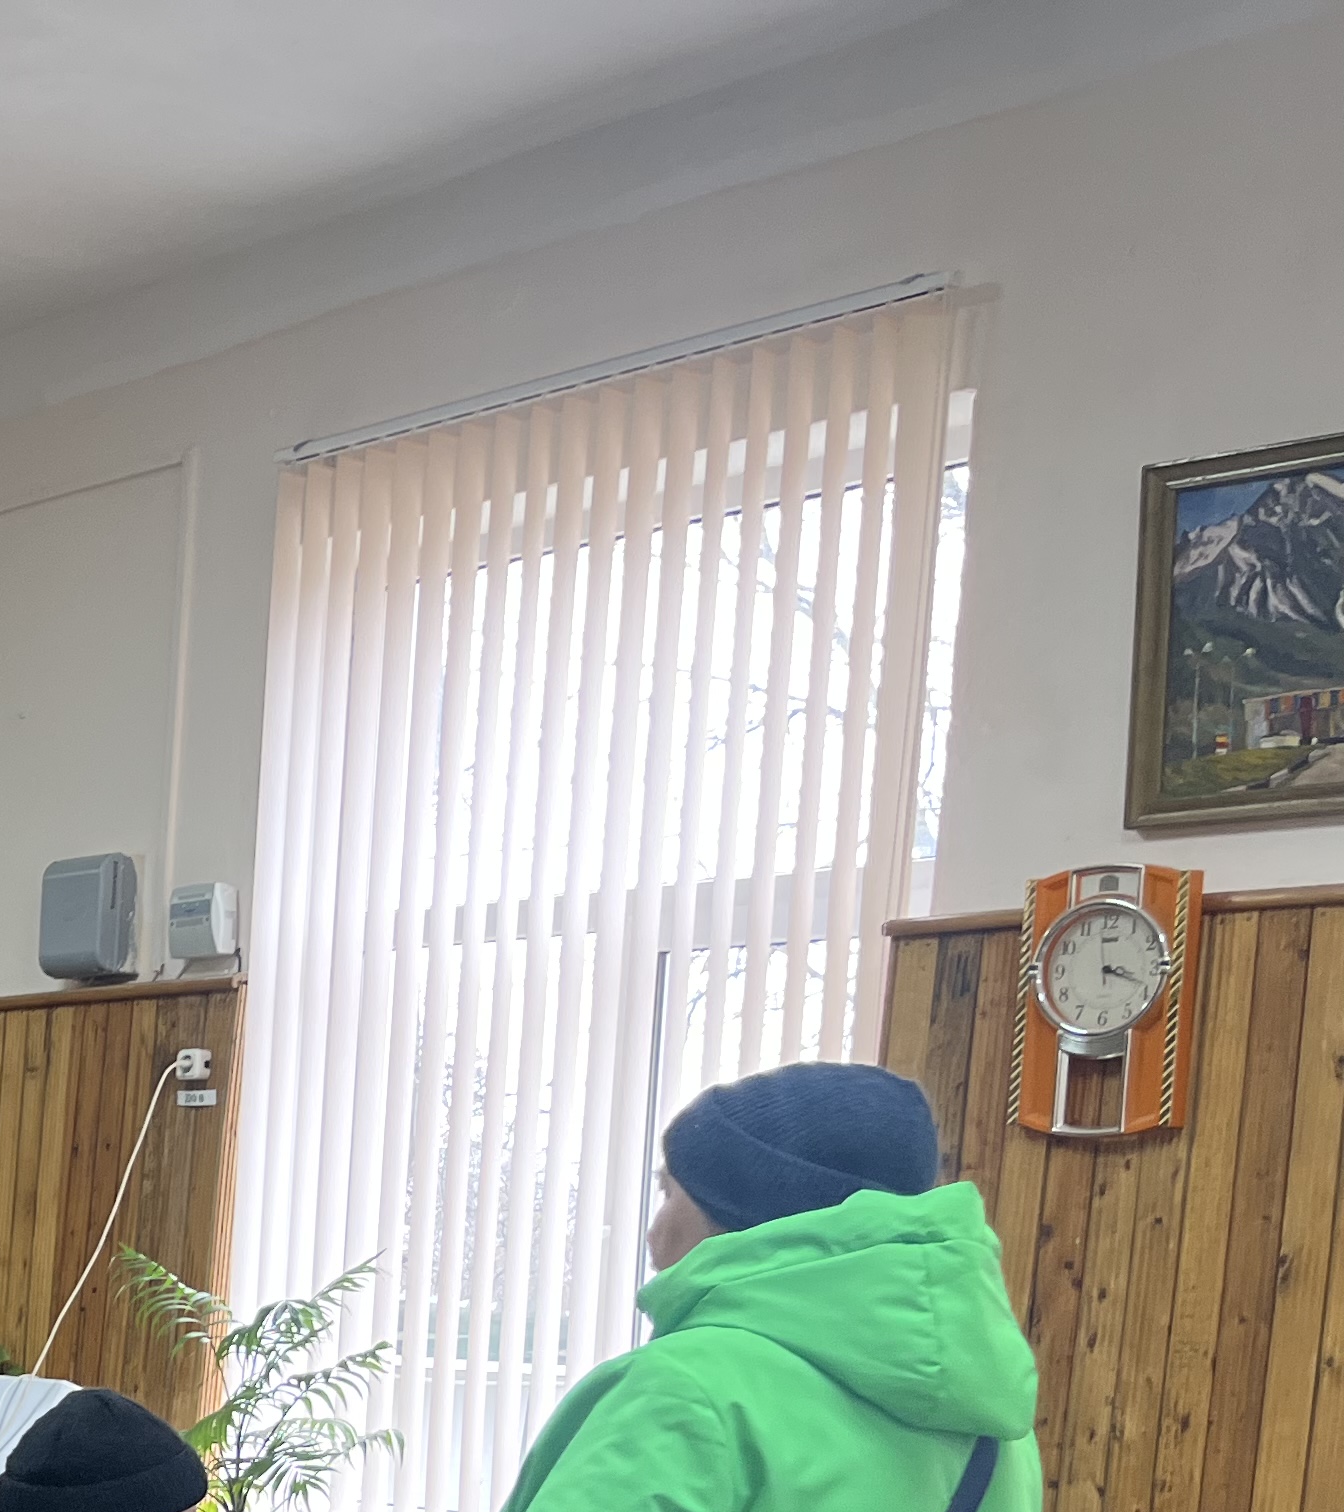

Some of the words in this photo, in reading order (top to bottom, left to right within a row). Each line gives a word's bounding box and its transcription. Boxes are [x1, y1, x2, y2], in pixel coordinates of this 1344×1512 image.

[1101, 915, 1120, 930] 12
[1061, 940, 1077, 956] 10
[1146, 935, 1157, 951] 2
[1054, 964, 1066, 981] 9
[1058, 987, 1069, 1003] 8
[1075, 1004, 1085, 1021] 7
[1097, 1010, 1109, 1026] 6
[1121, 1003, 1132, 1019] 5
